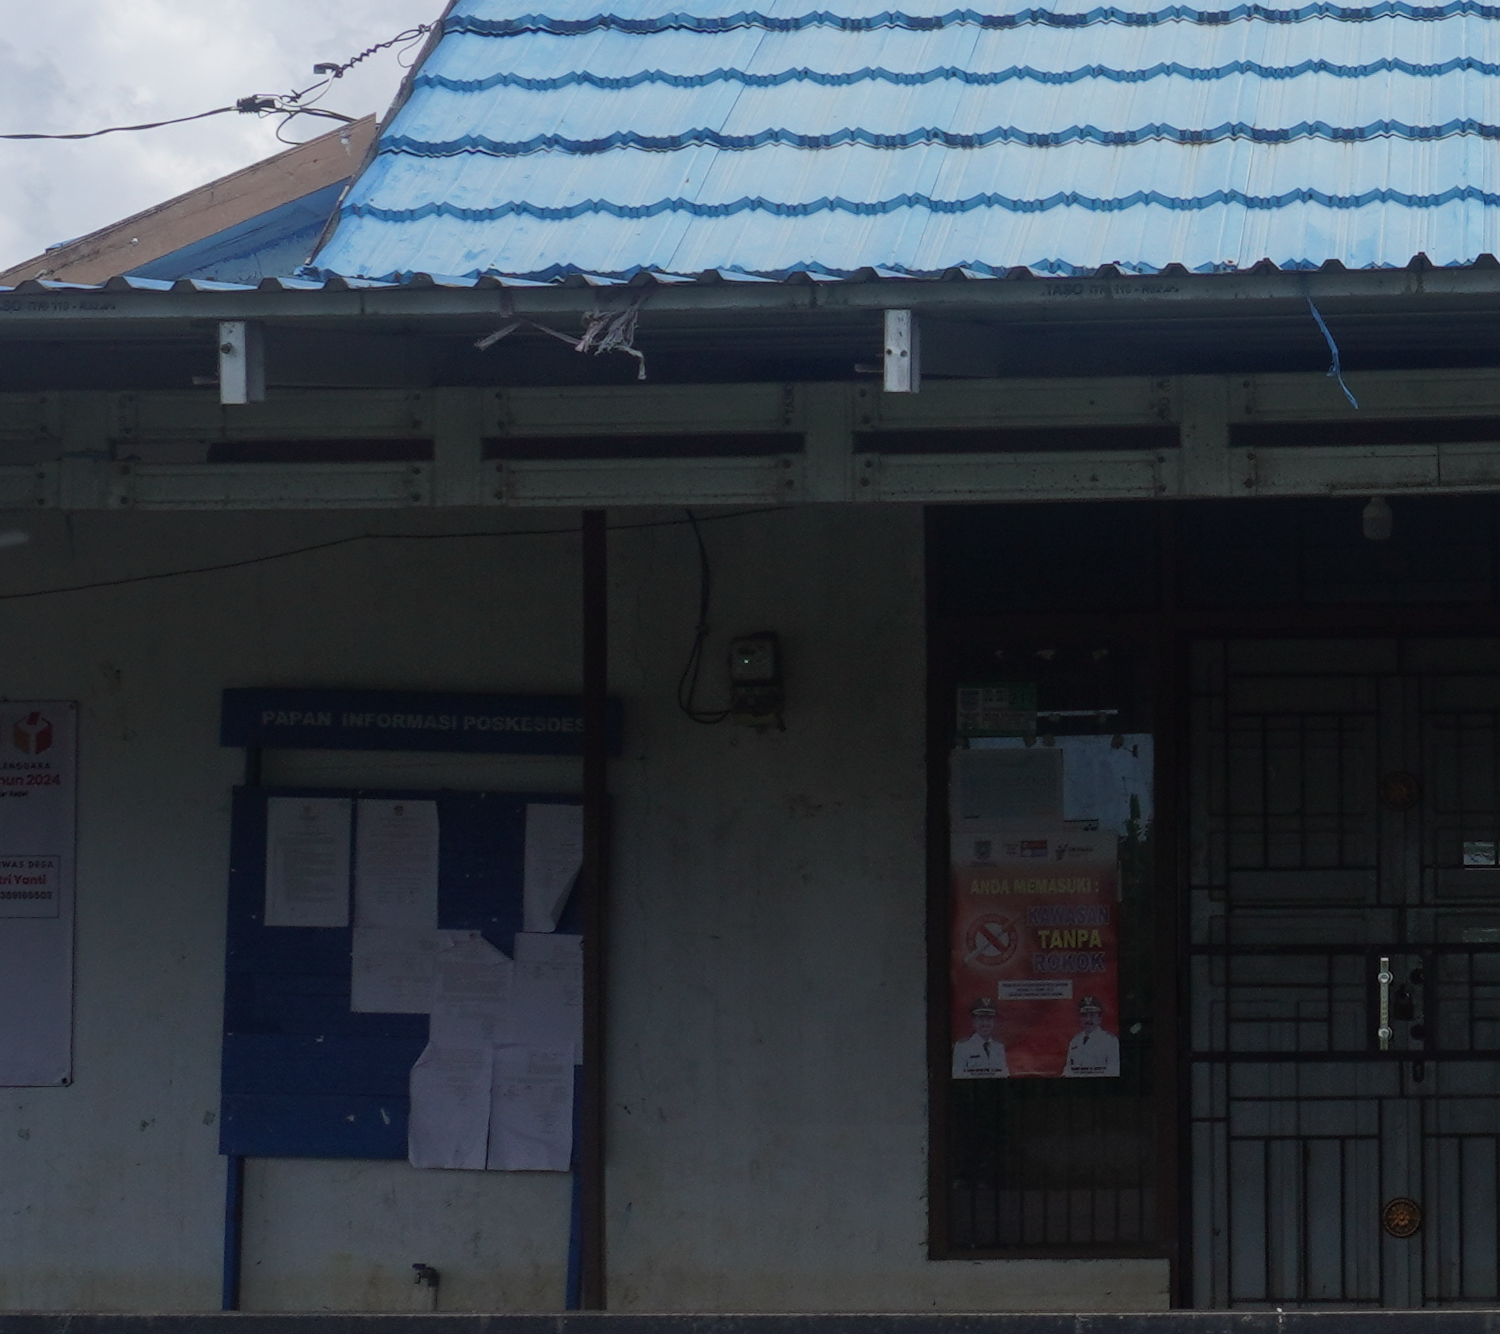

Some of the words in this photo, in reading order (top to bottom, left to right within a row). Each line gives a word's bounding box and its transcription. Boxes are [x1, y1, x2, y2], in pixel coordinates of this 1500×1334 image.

[262, 710, 331, 727] PAPAN
[341, 713, 456, 730] INFORMASI
[26, 773, 60, 786] 2024
[28, 860, 53, 868] DESA
[14, 873, 46, 885] Yanti
[971, 880, 1010, 895] ANDA
[1014, 878, 1091, 894] MEMASUKI
[1026, 905, 1110, 926] KAWASAN
[1037, 929, 1103, 949] TANPA
[1032, 952, 1106, 973] ROKOK
